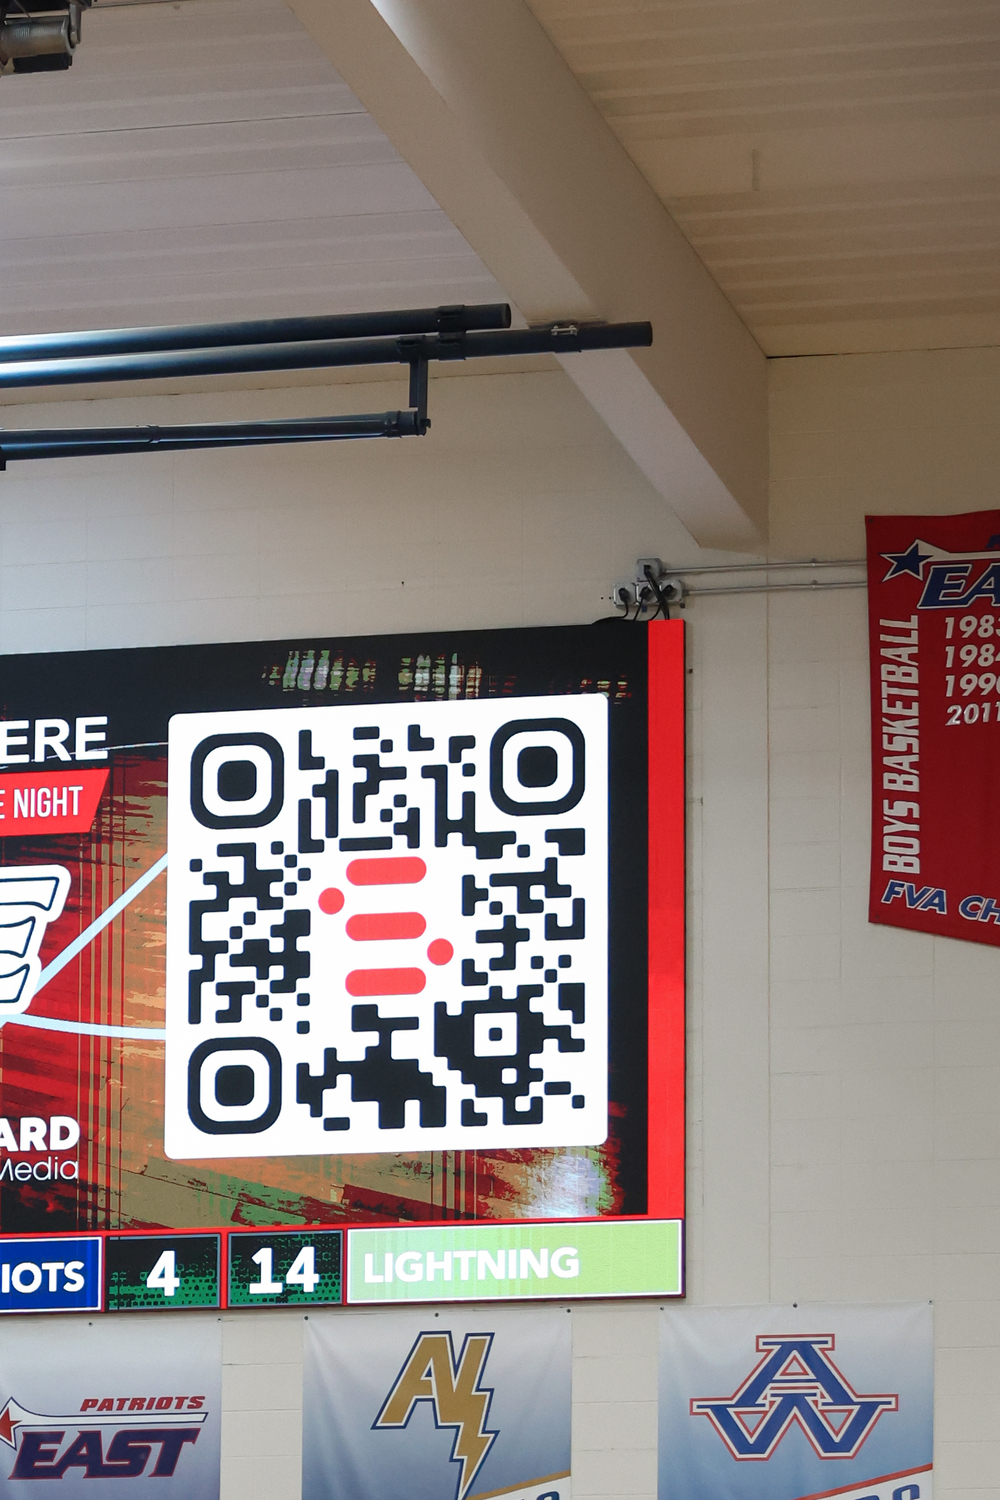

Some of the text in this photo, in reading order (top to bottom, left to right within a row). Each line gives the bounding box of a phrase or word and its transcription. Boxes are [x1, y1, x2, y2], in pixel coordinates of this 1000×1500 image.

[879, 614, 920, 793] BASKETBALL
[14, 785, 83, 818] NIGHT
[882, 799, 920, 874] BOYS
[881, 879, 947, 915] FVA
[146, 1250, 180, 1297] 4
[248, 1245, 319, 1295] 14
[364, 1247, 580, 1285] LIGHTNING
[80, 1395, 205, 1412] PATRIOTS
[7, 1428, 202, 1480] EAST
